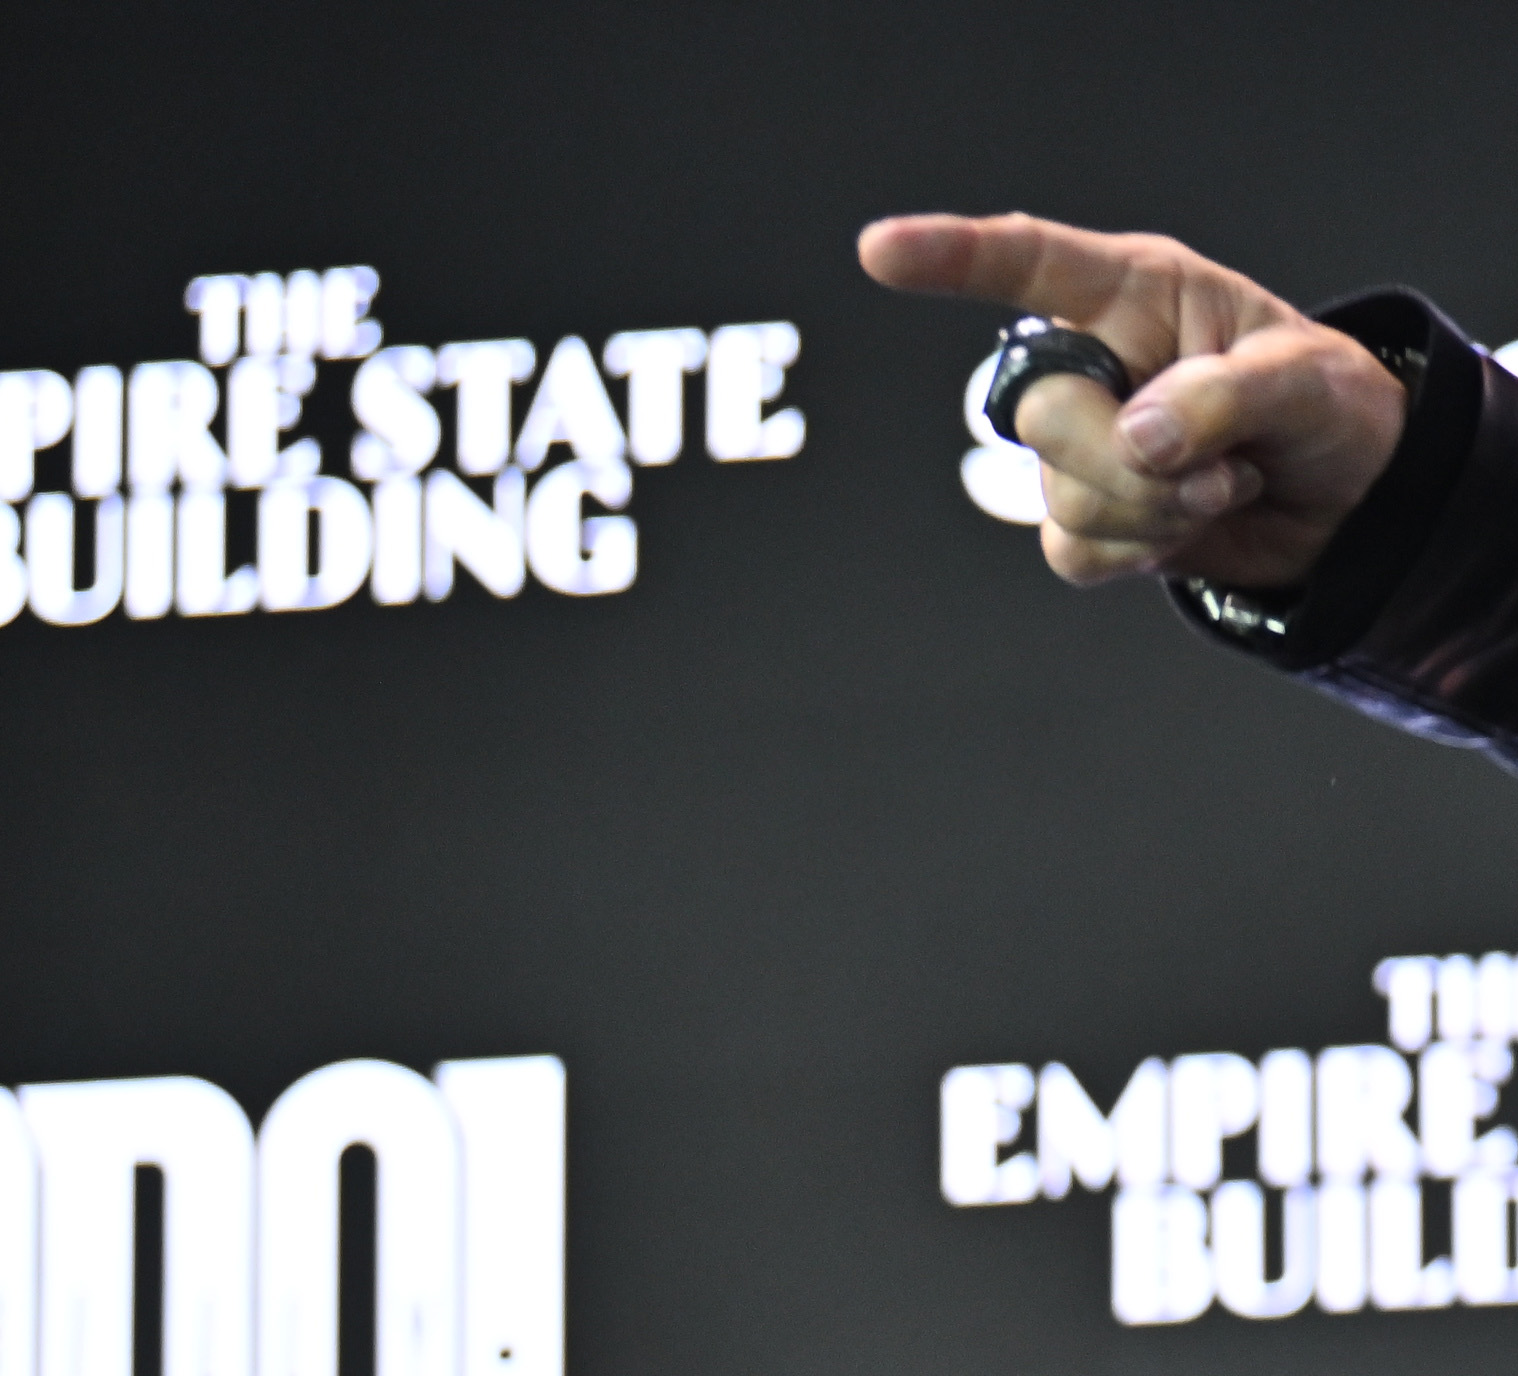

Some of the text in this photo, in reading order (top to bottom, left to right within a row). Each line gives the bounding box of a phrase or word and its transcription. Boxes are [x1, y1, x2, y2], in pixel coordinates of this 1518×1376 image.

[185, 265, 383, 366] THE
[350, 321, 806, 481] STATE
[0, 457, 640, 627] UILDING
